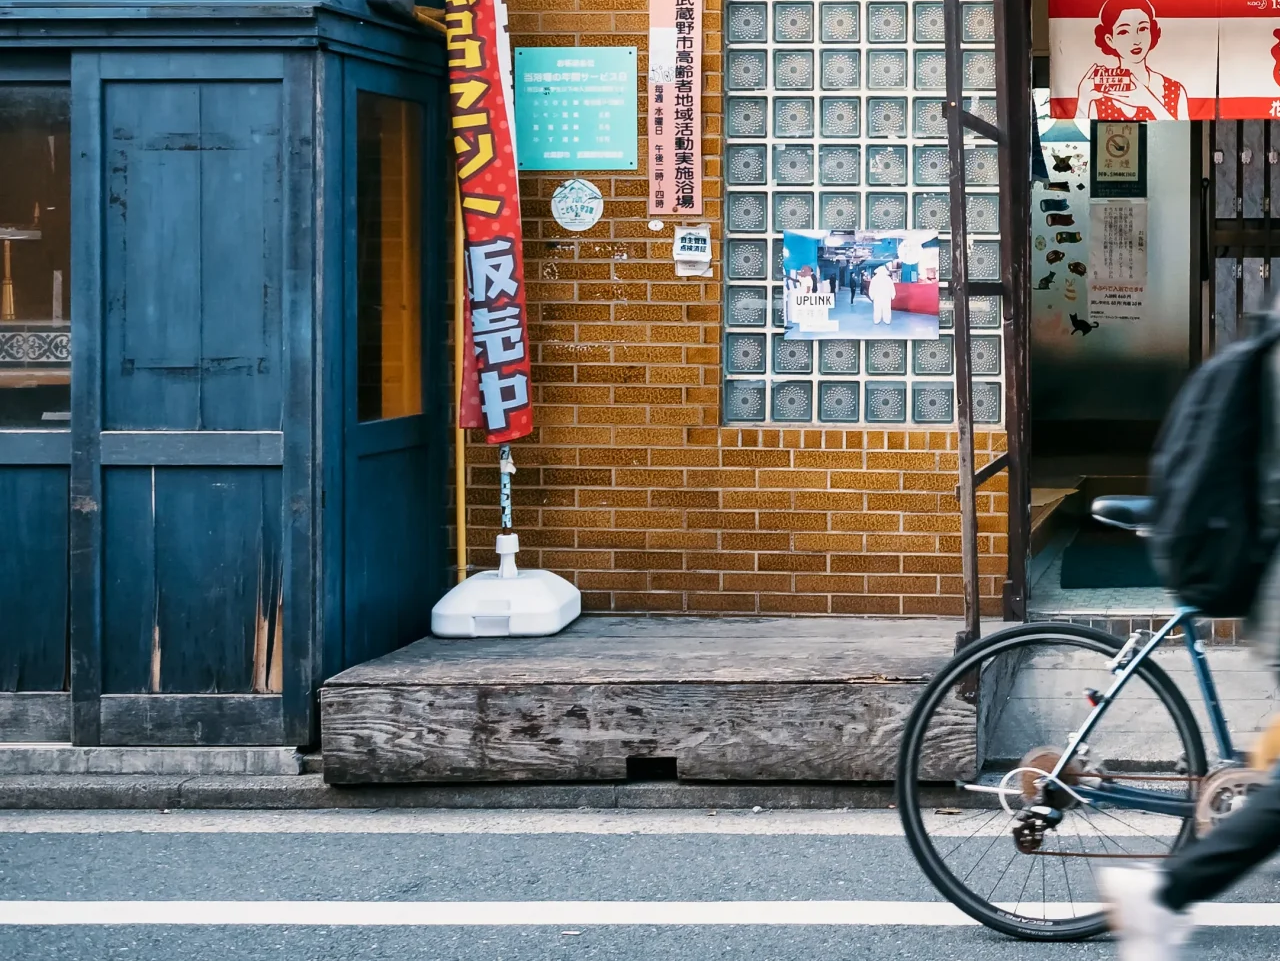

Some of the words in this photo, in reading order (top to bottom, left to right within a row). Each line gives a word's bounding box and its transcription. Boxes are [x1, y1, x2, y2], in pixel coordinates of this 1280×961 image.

[654, 85, 664, 103] 毎週
[654, 106, 664, 136] 水曜日
[796, 296, 831, 305] UPLINK
